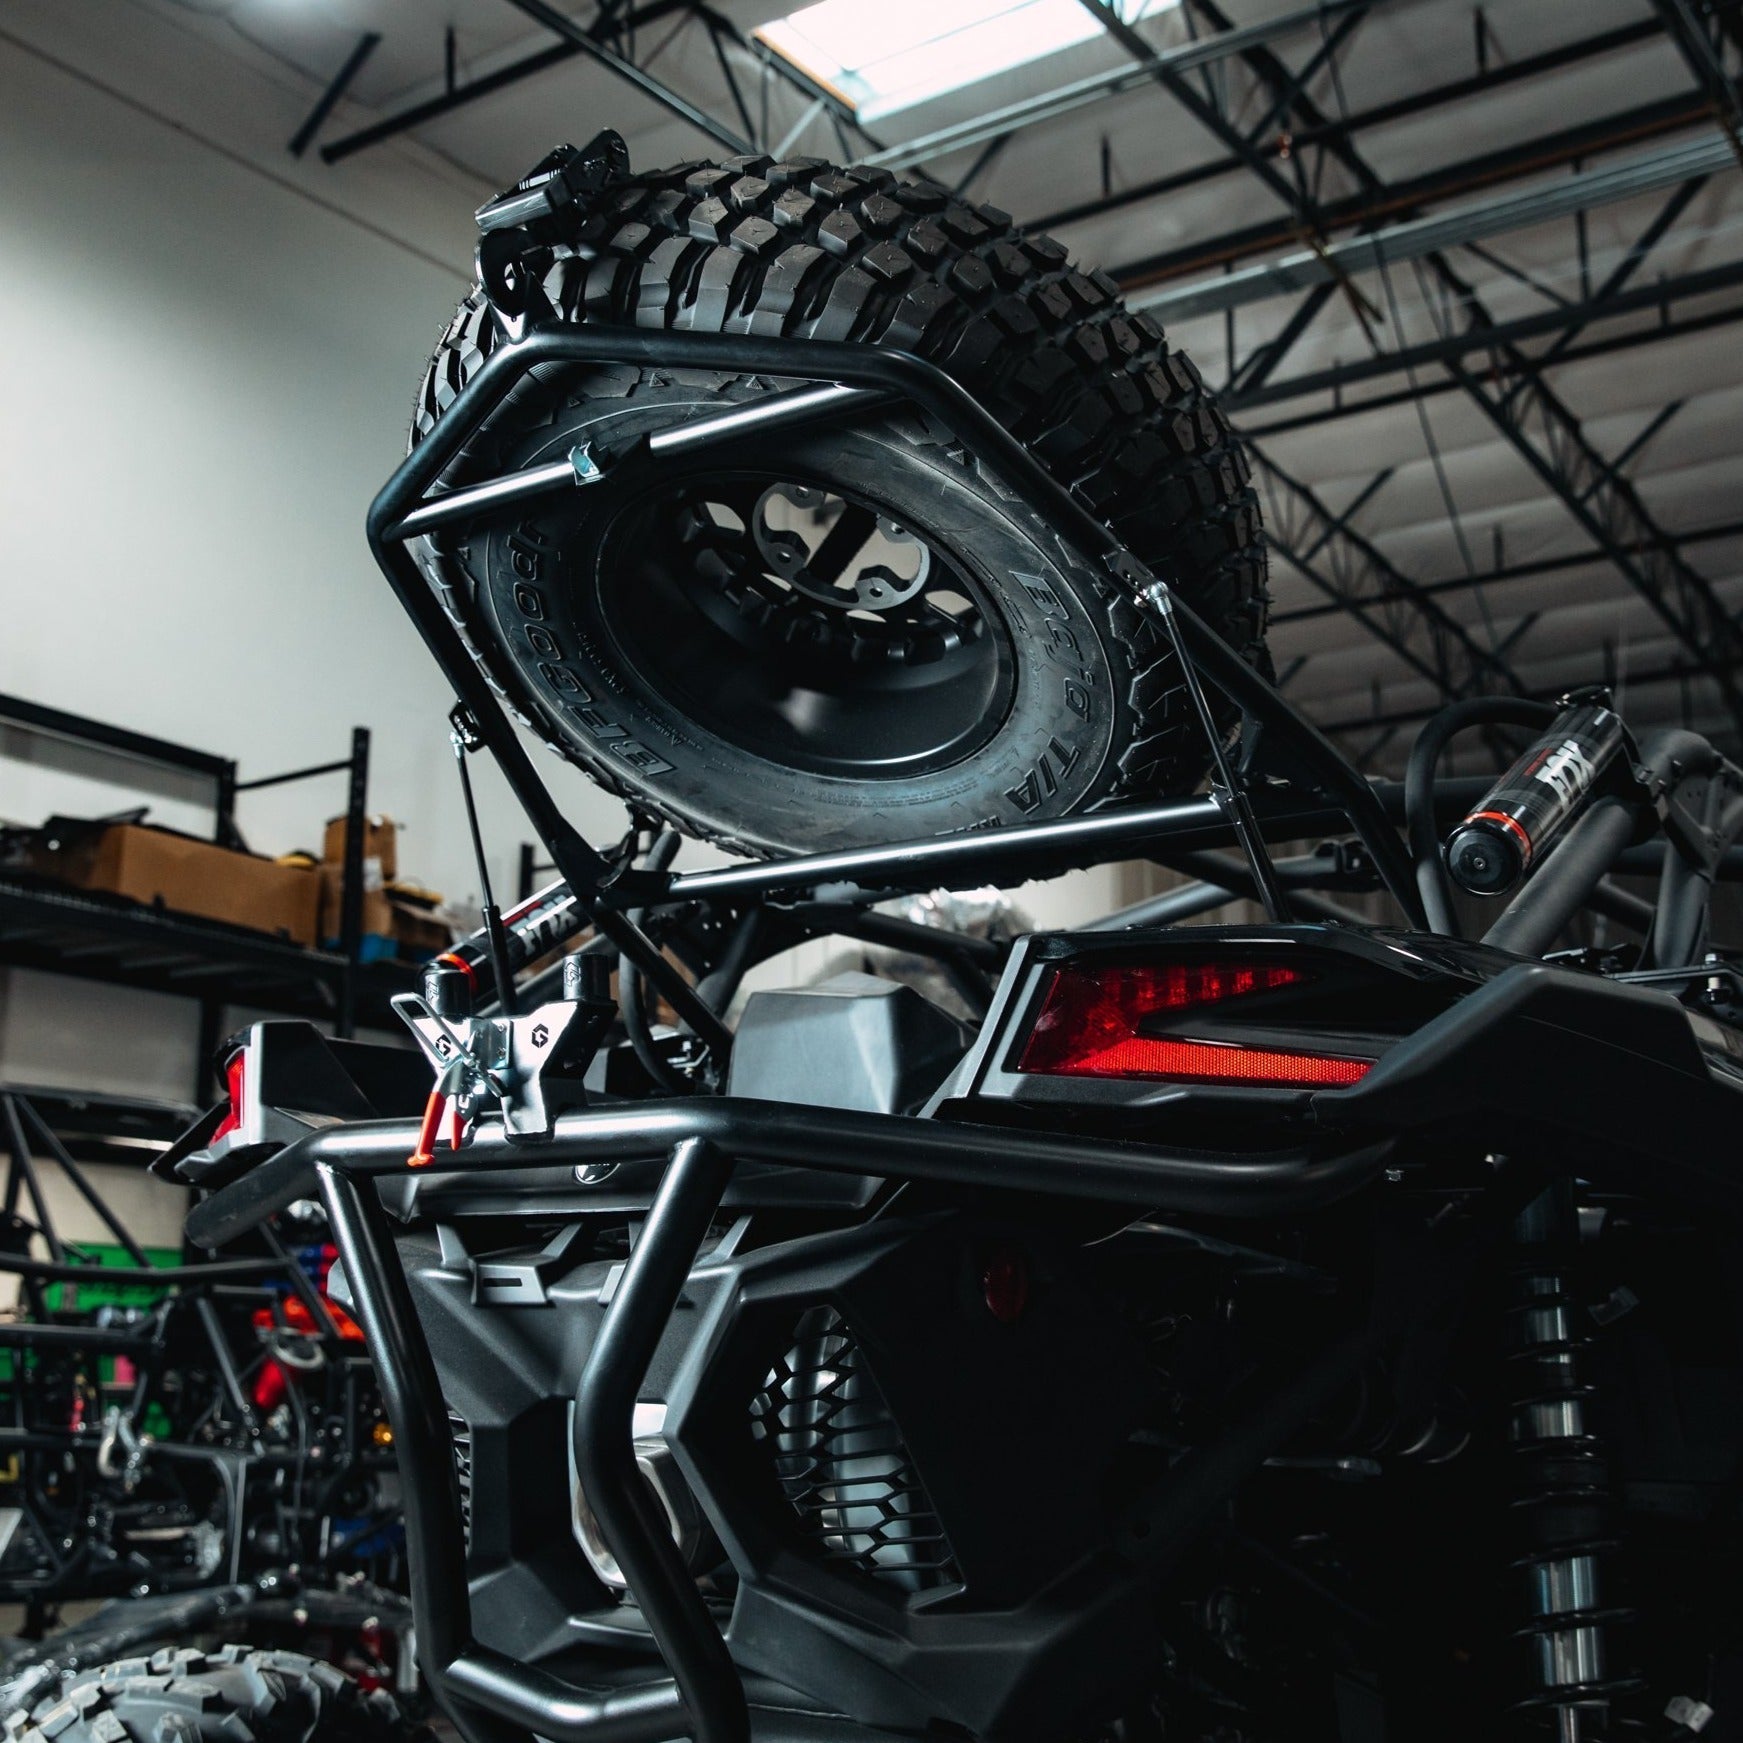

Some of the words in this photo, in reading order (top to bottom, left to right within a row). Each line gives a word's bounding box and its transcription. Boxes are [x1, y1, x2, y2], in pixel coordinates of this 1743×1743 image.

[506, 520, 677, 777] BFGoodr
[1003, 736, 1081, 816] T/A
[1534, 739, 1595, 811] FOX
[509, 894, 579, 950] FOX
